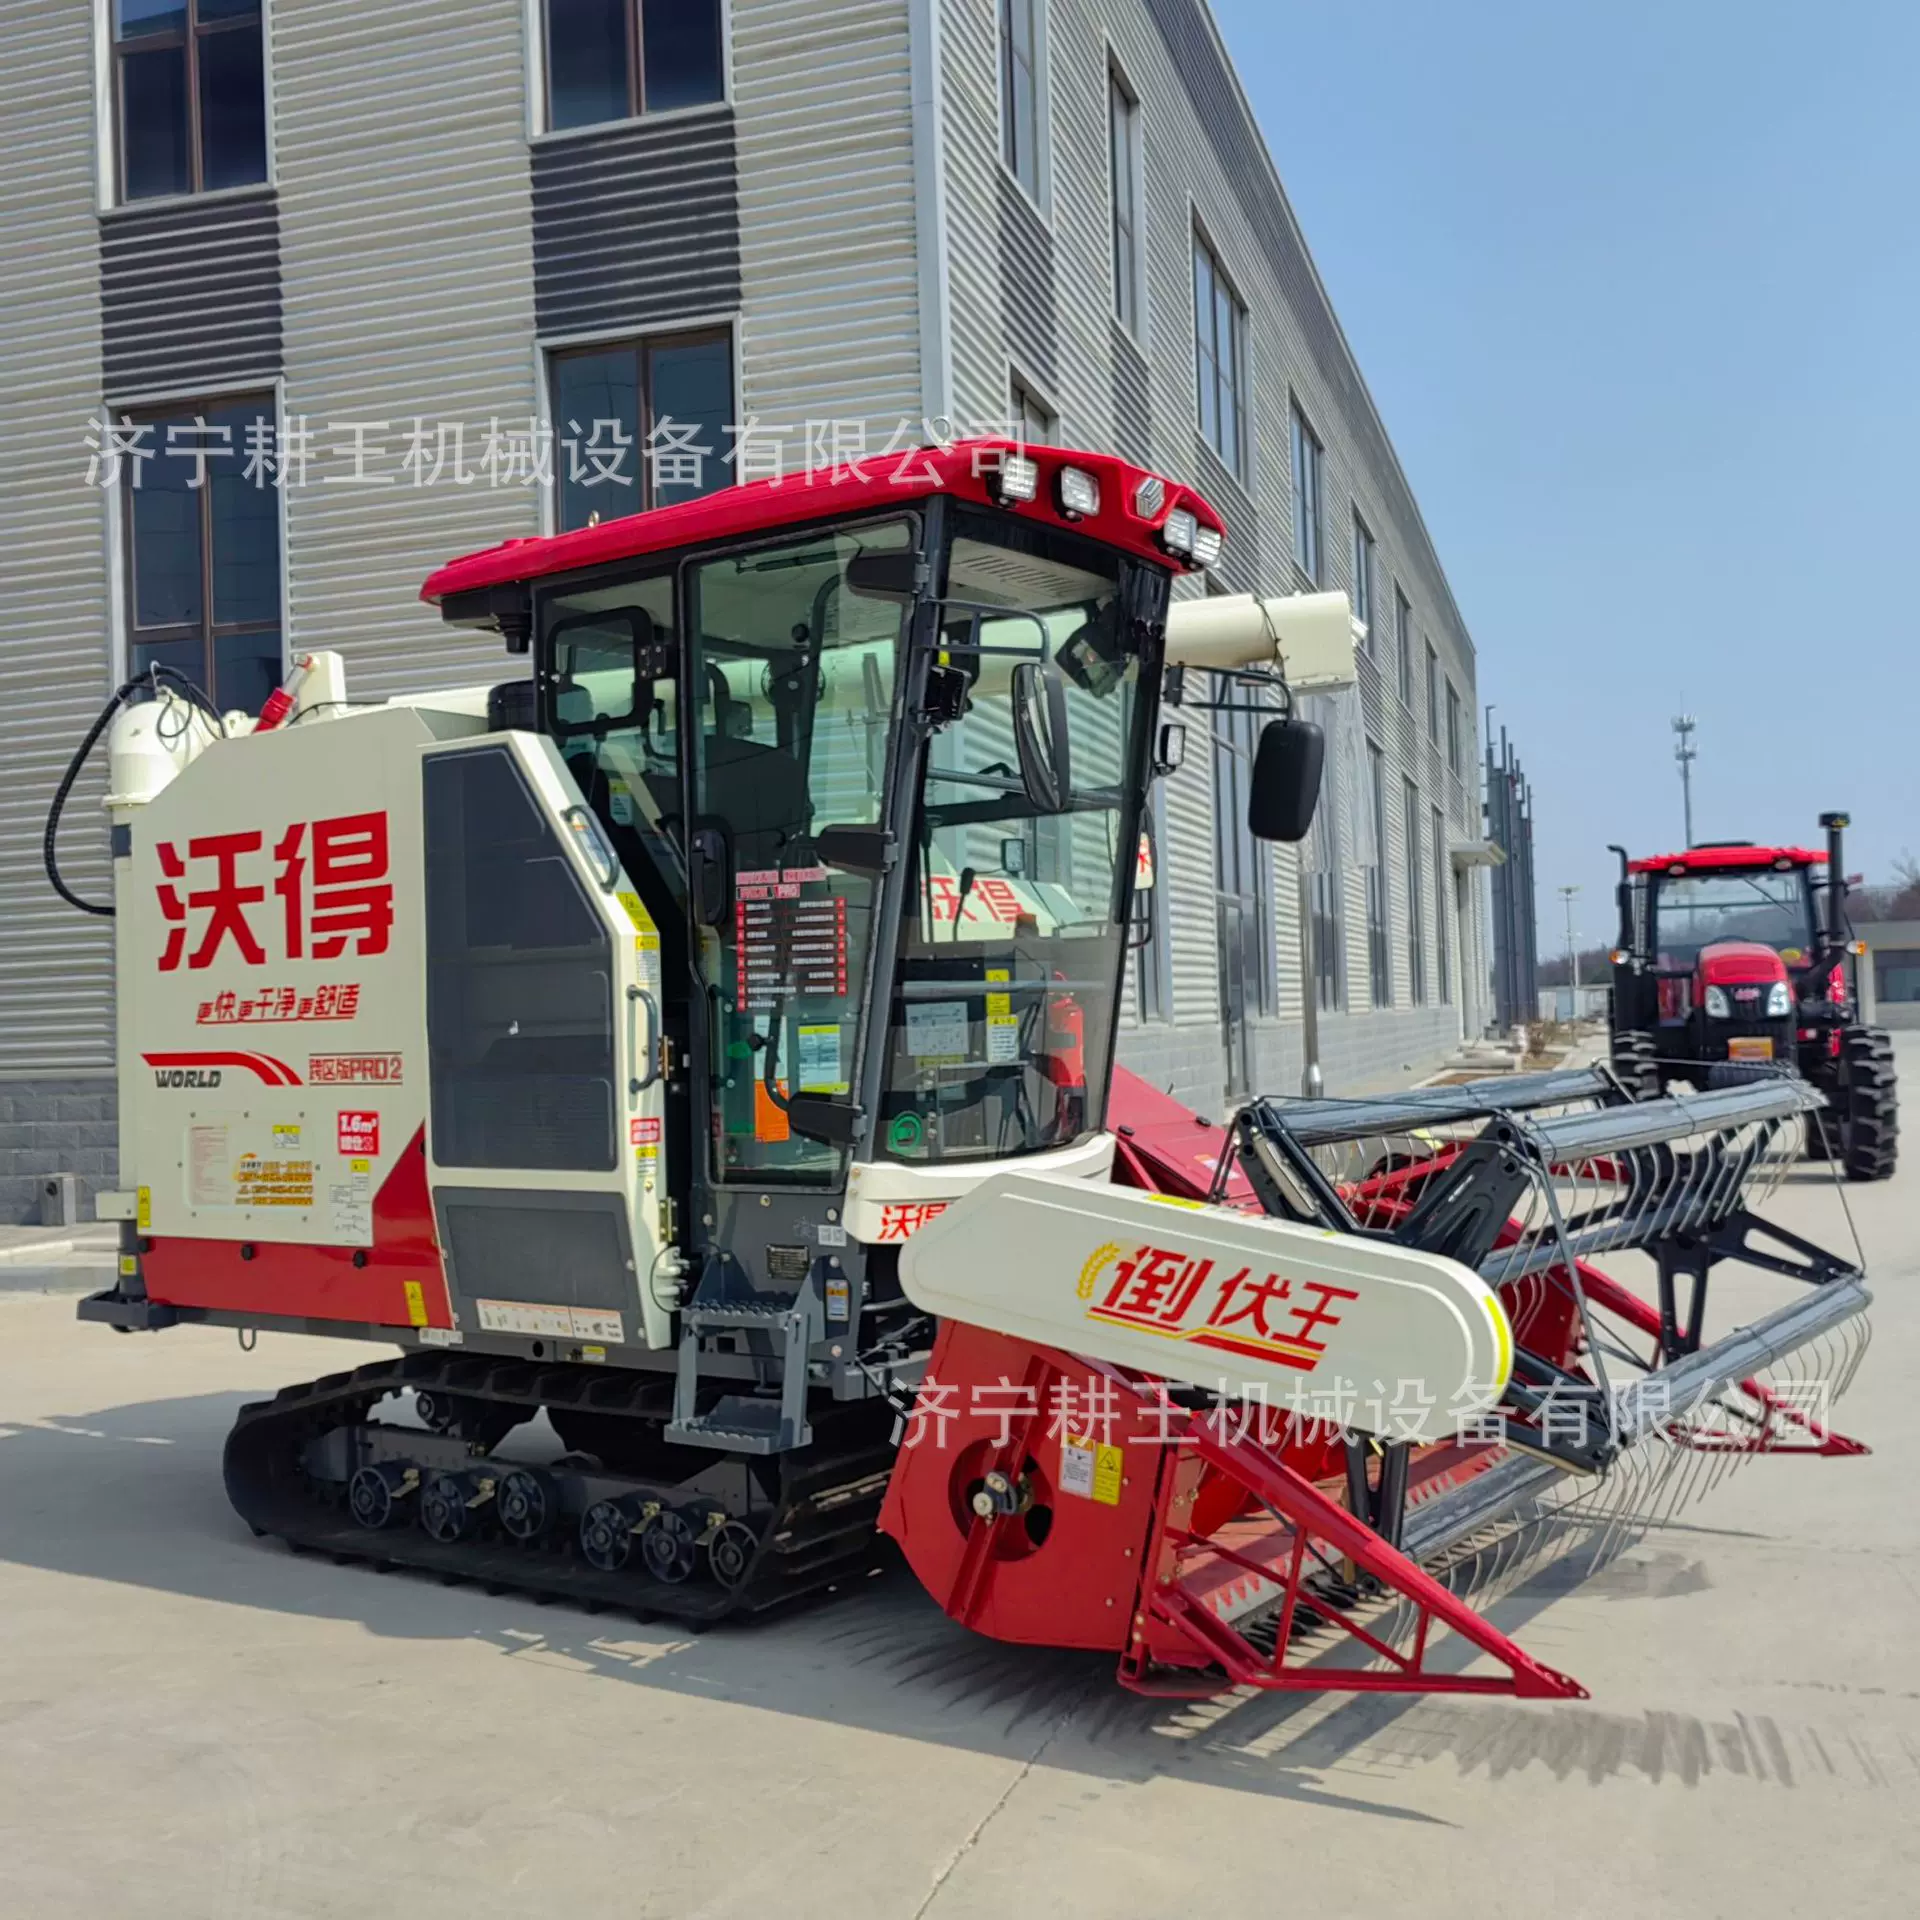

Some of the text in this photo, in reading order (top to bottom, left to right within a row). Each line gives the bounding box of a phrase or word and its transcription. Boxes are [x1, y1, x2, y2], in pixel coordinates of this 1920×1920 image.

[156, 810, 393, 972] 沃得
[197, 984, 360, 1023] 更快更干净更舒适
[155, 1069, 222, 1088] WORLD
[1102, 1244, 1359, 1351] 倒伏王
